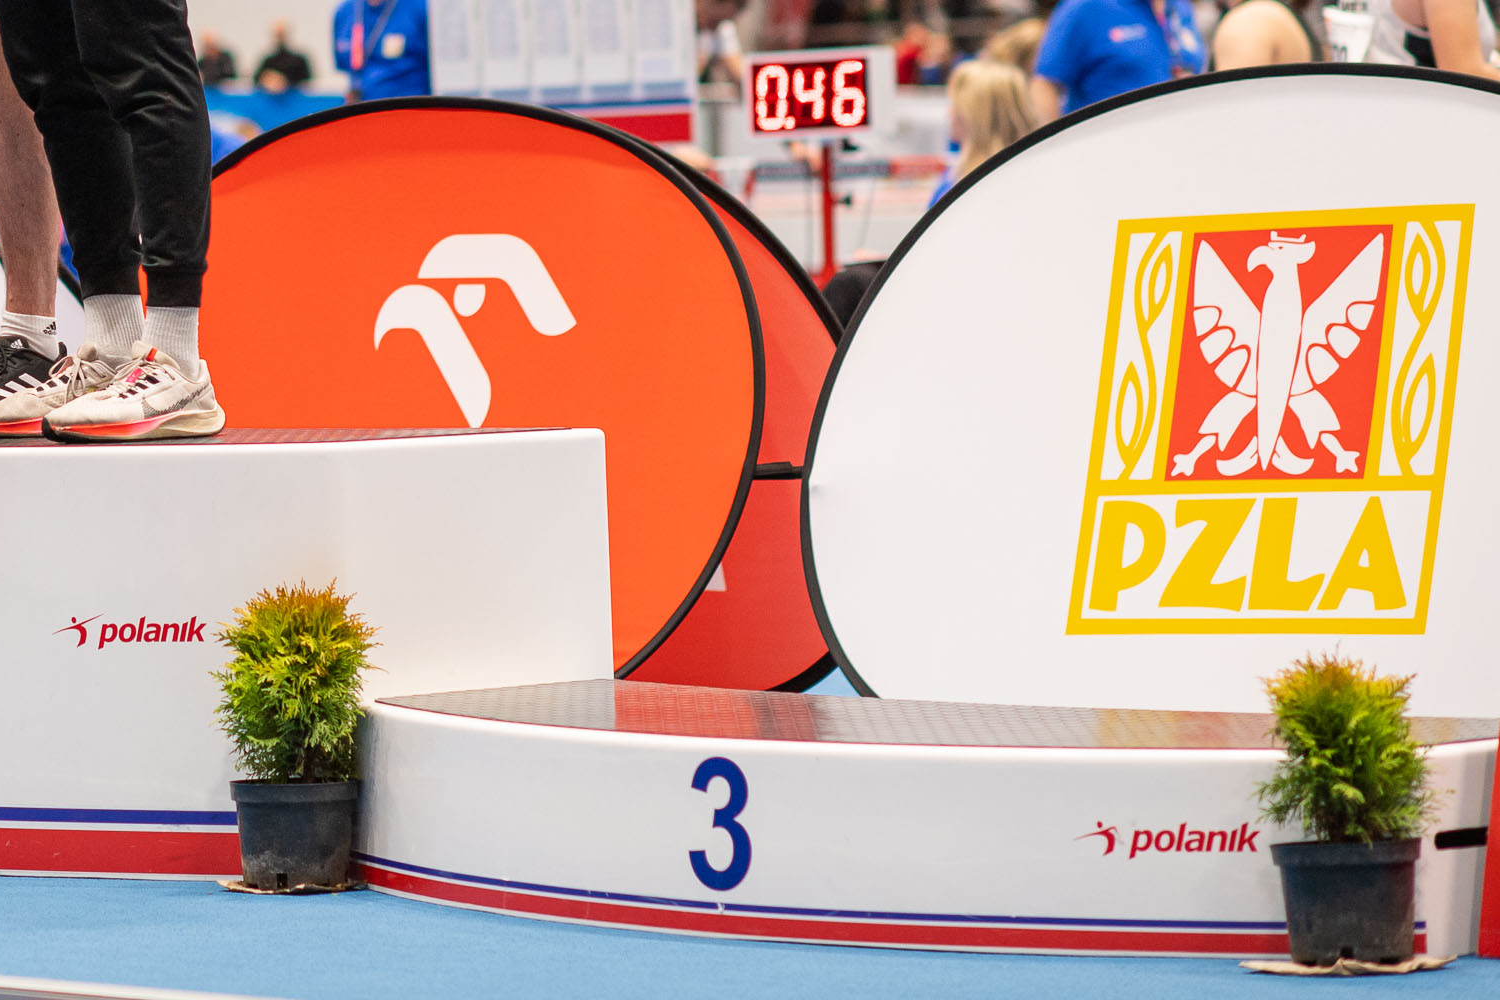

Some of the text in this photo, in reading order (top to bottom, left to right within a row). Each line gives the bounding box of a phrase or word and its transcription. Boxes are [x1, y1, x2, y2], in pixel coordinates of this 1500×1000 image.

[1088, 495, 1407, 612] PZLA
[98, 616, 206, 650] polanik
[688, 756, 753, 891] 3
[1129, 822, 1260, 860] polanik
